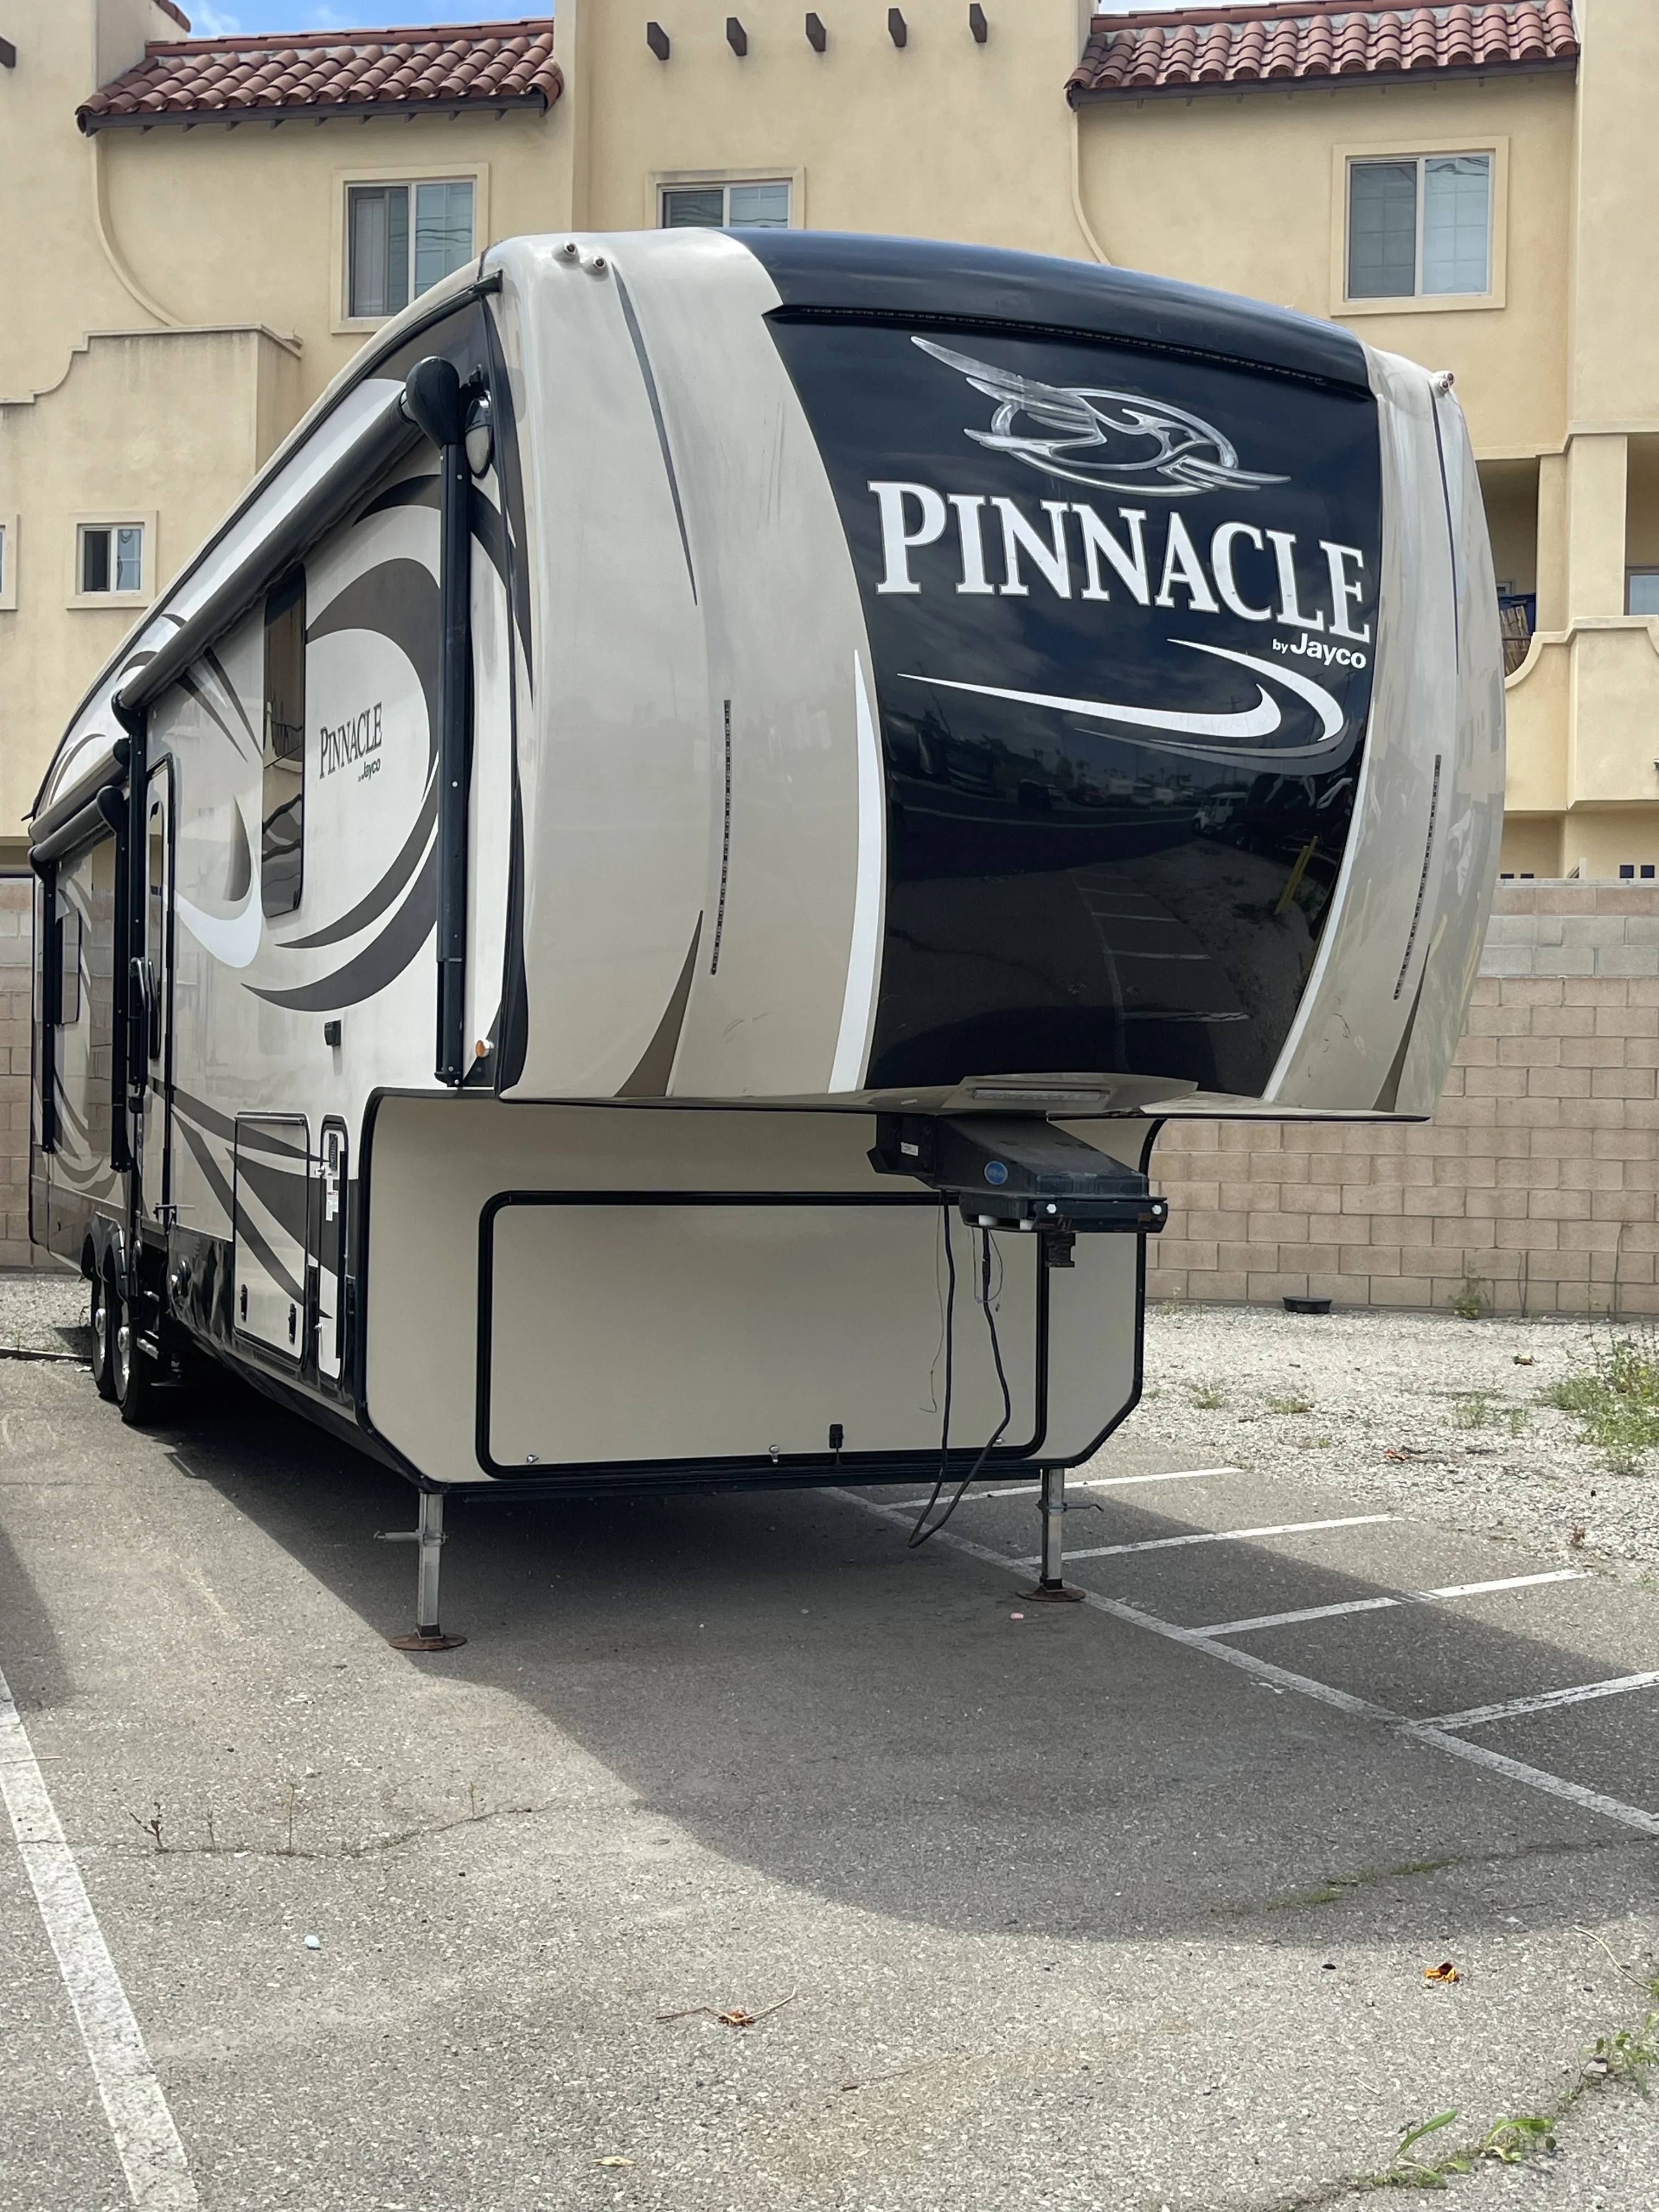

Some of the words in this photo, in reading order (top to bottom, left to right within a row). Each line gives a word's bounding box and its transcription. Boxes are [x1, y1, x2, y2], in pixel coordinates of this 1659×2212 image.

[868, 481, 1370, 644] PINNACLE
[1272, 638, 1288, 654] by
[1290, 633, 1367, 669] Jayco
[319, 702, 382, 780] PINNACLE
